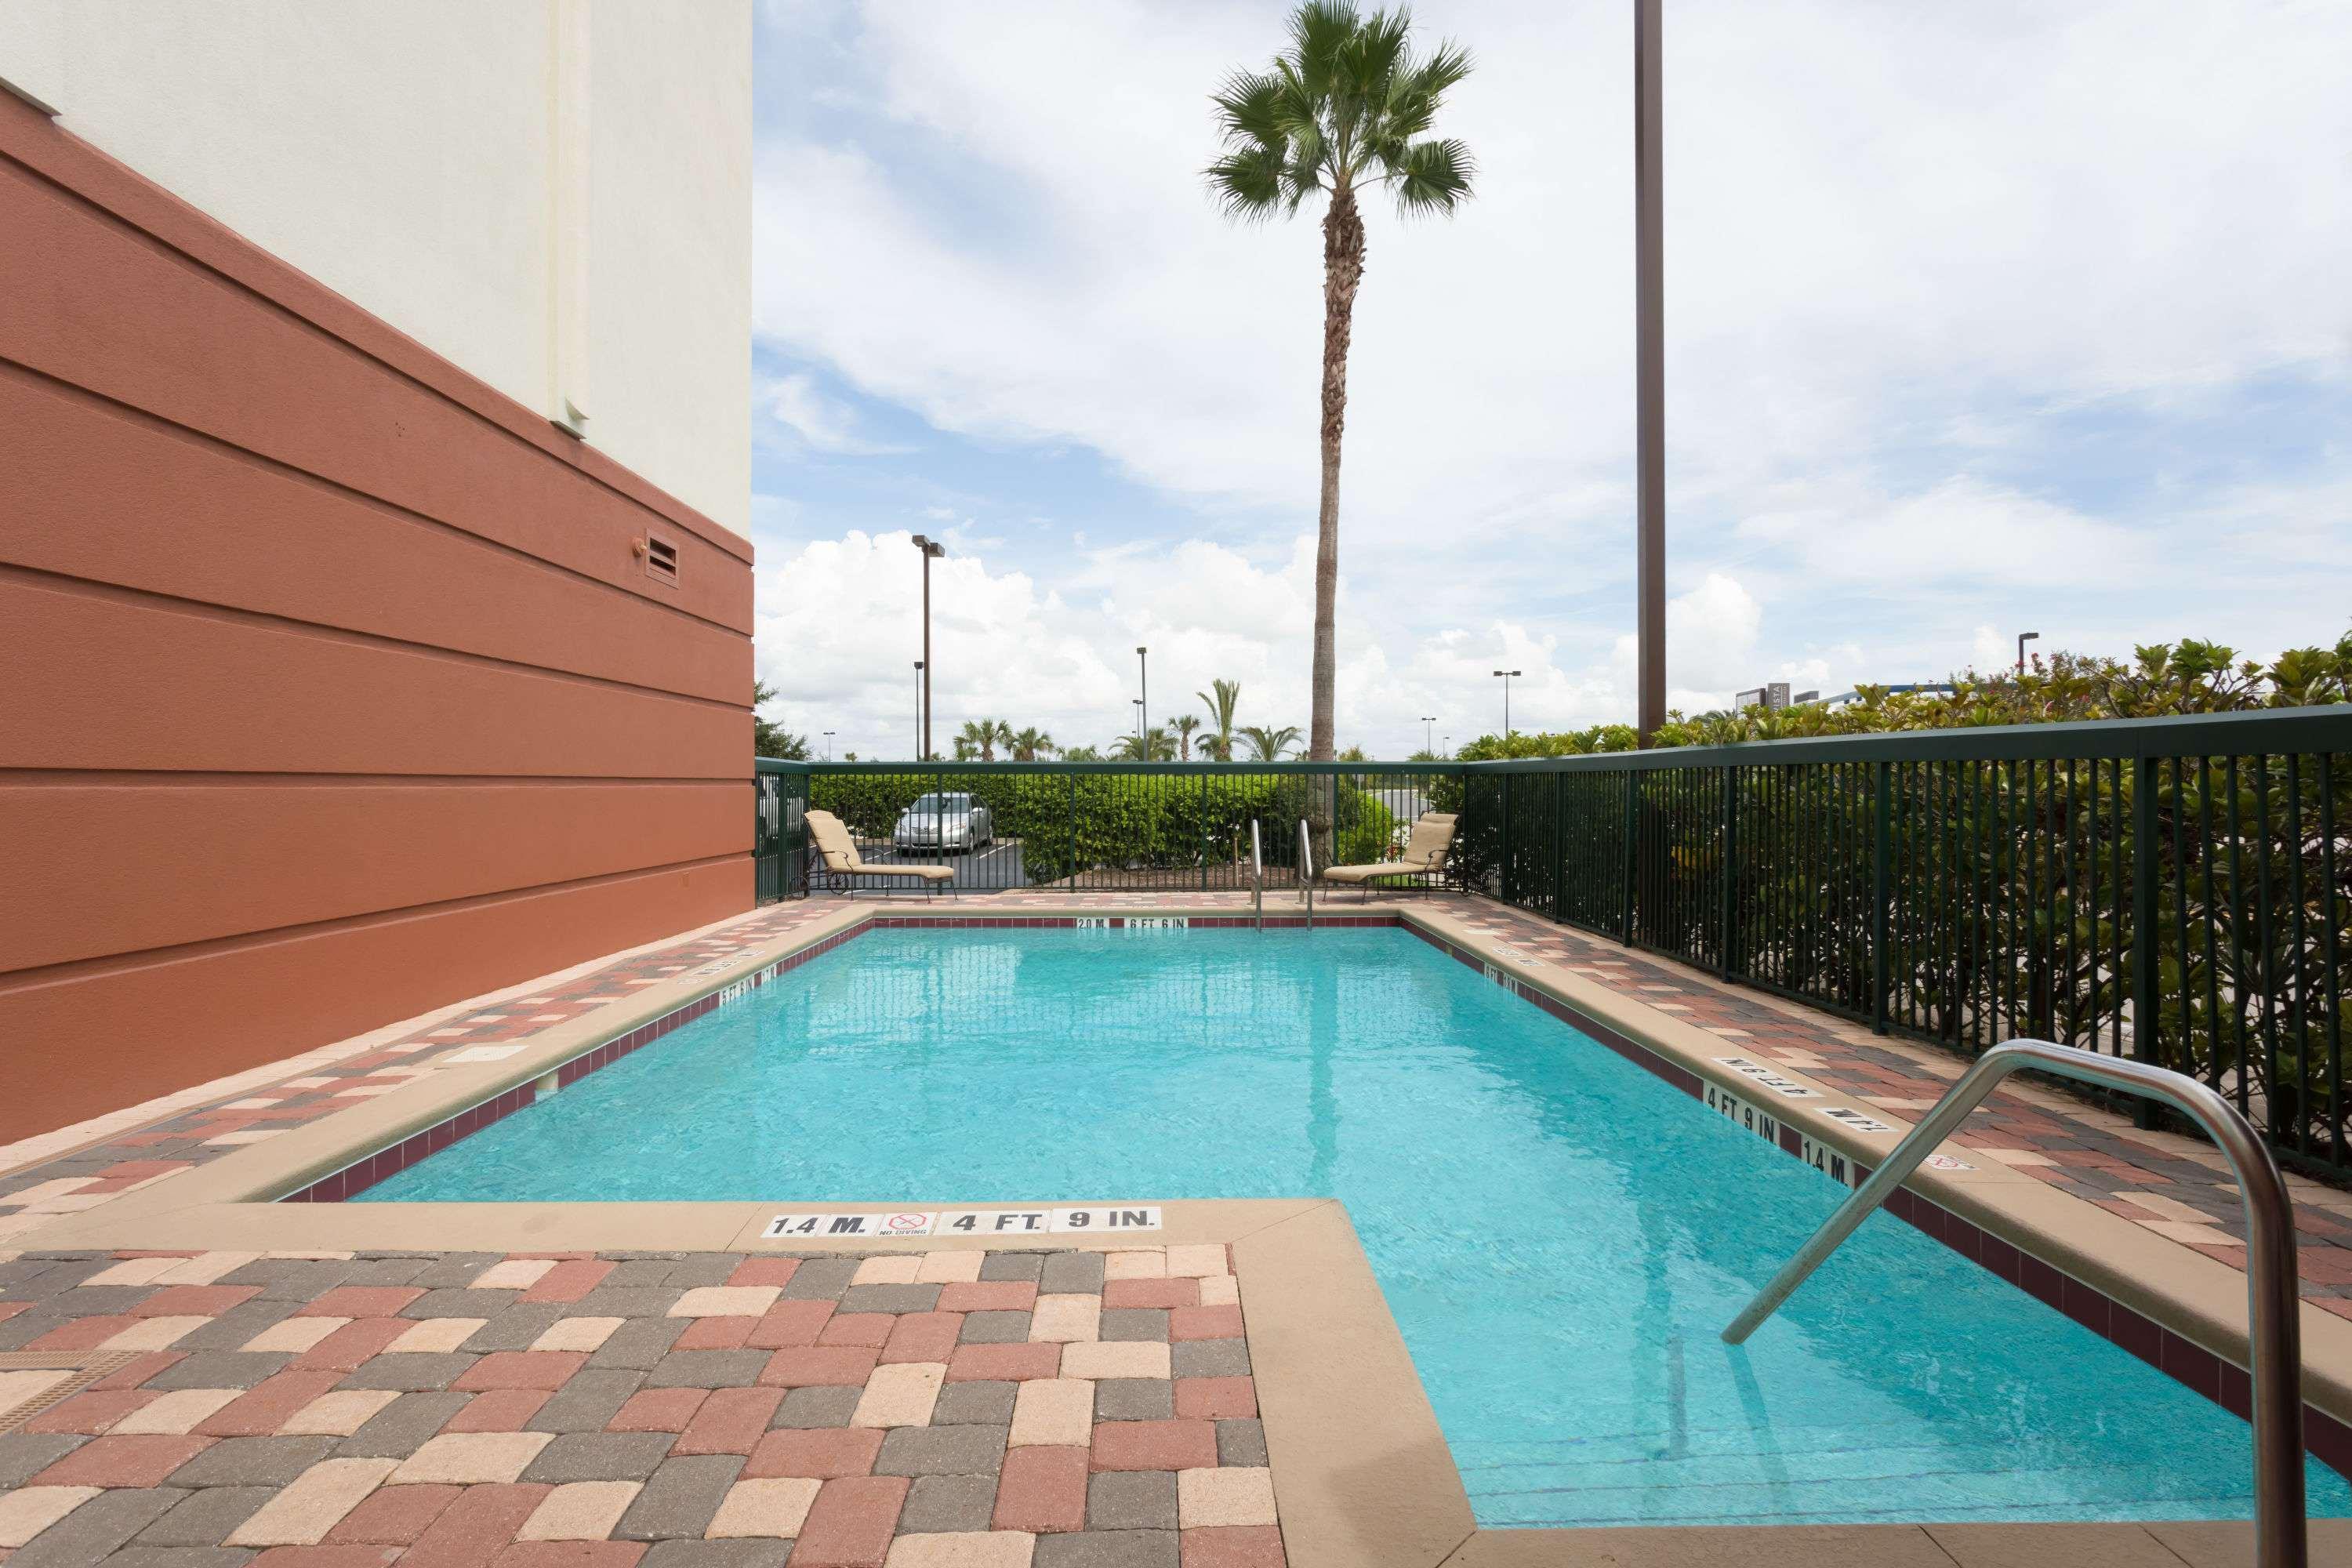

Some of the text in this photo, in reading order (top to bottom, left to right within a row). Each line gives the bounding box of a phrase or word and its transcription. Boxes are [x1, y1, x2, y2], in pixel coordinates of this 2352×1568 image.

[1130, 918, 1137, 929] 6
[1161, 918, 1168, 929] 6
[1708, 1087, 1715, 1109] 4
[1744, 1107, 1753, 1131] 9
[772, 1210, 1156, 1234] 1.4 M. 4 FT. 9 IN.
